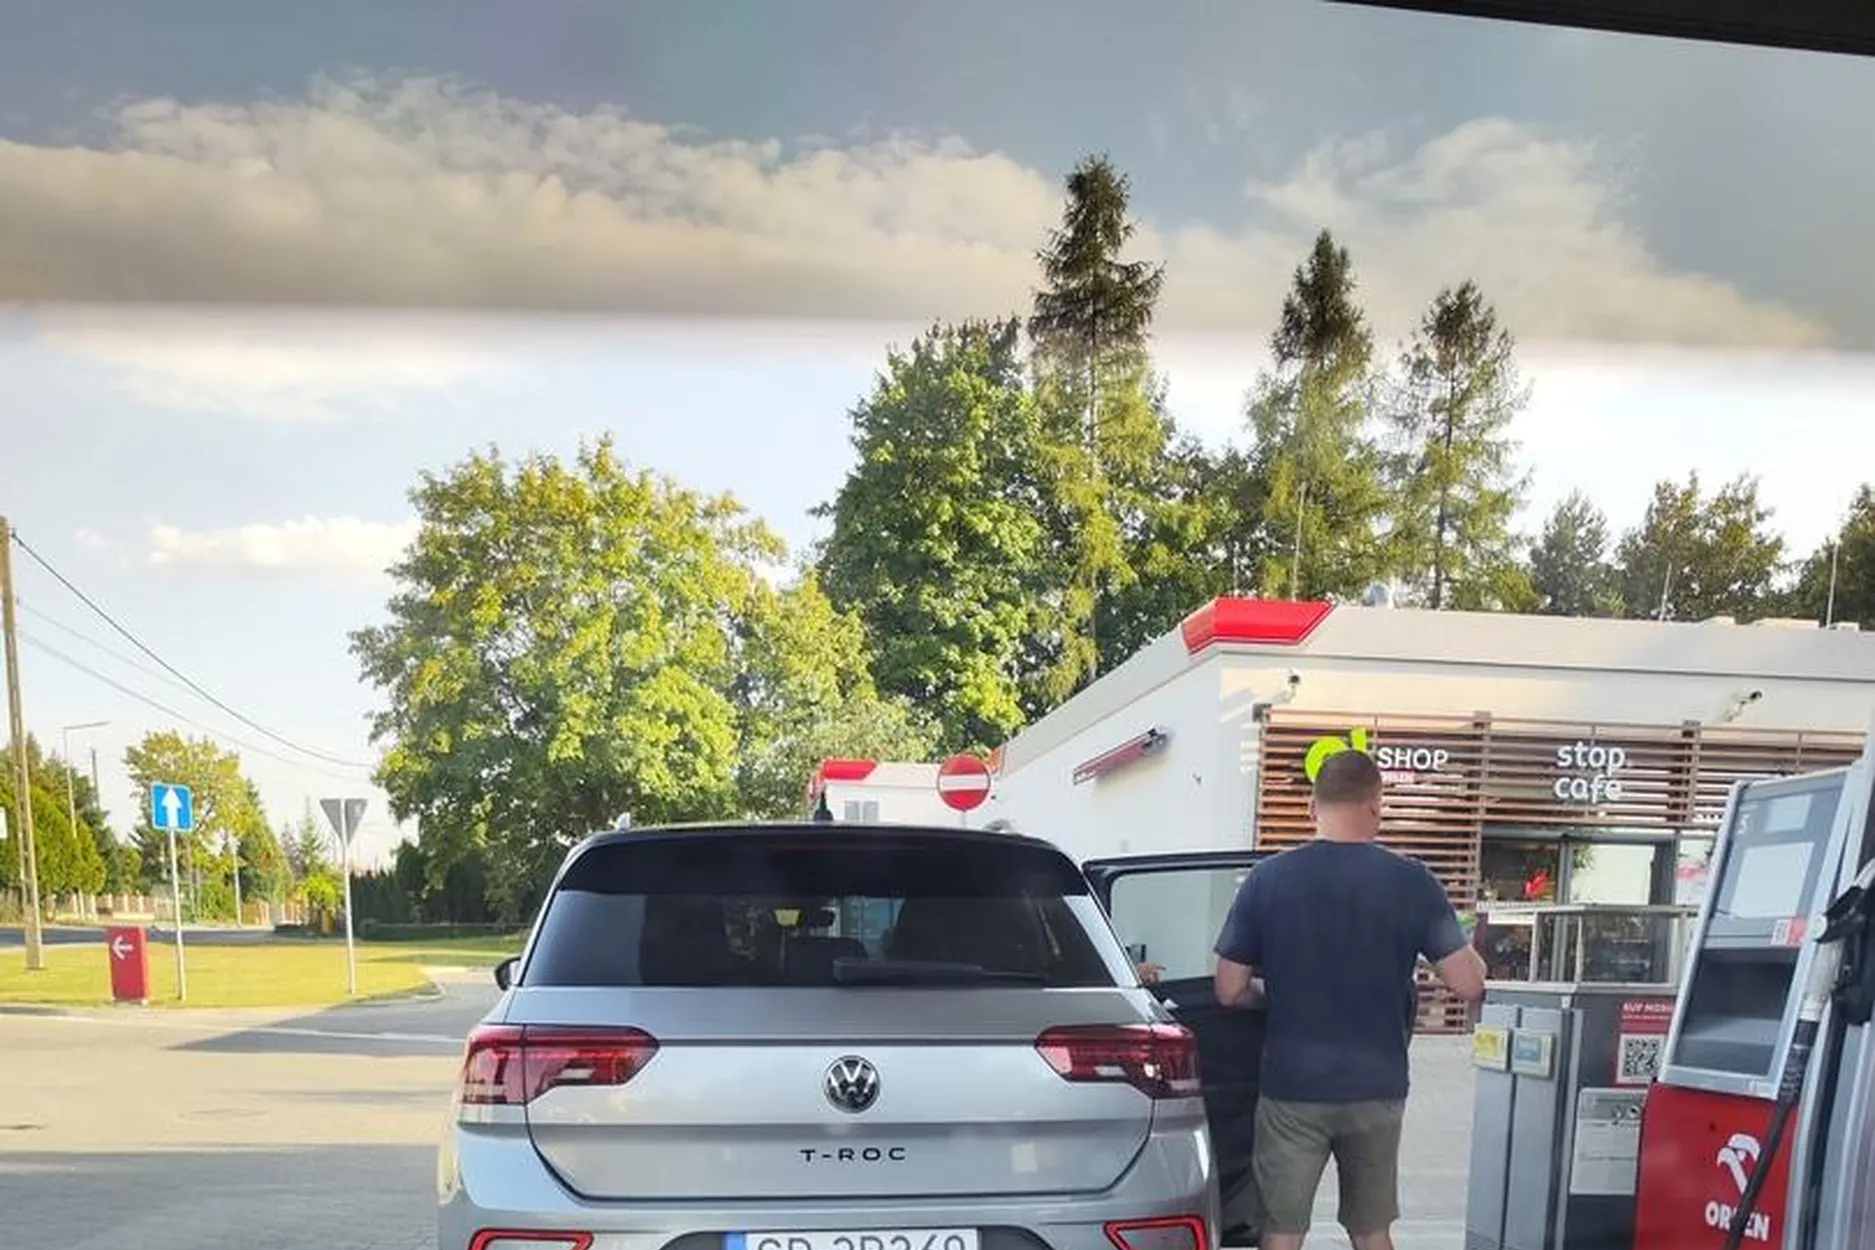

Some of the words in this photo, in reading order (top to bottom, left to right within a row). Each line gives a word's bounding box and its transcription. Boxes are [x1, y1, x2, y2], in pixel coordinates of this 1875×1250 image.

[1377, 747, 1448, 771] SHOP
[1557, 741, 1625, 777] stop
[1555, 774, 1622, 804] cafe
[800, 1147, 906, 1162] T-ROC
[1705, 1200, 1770, 1241] OREN
